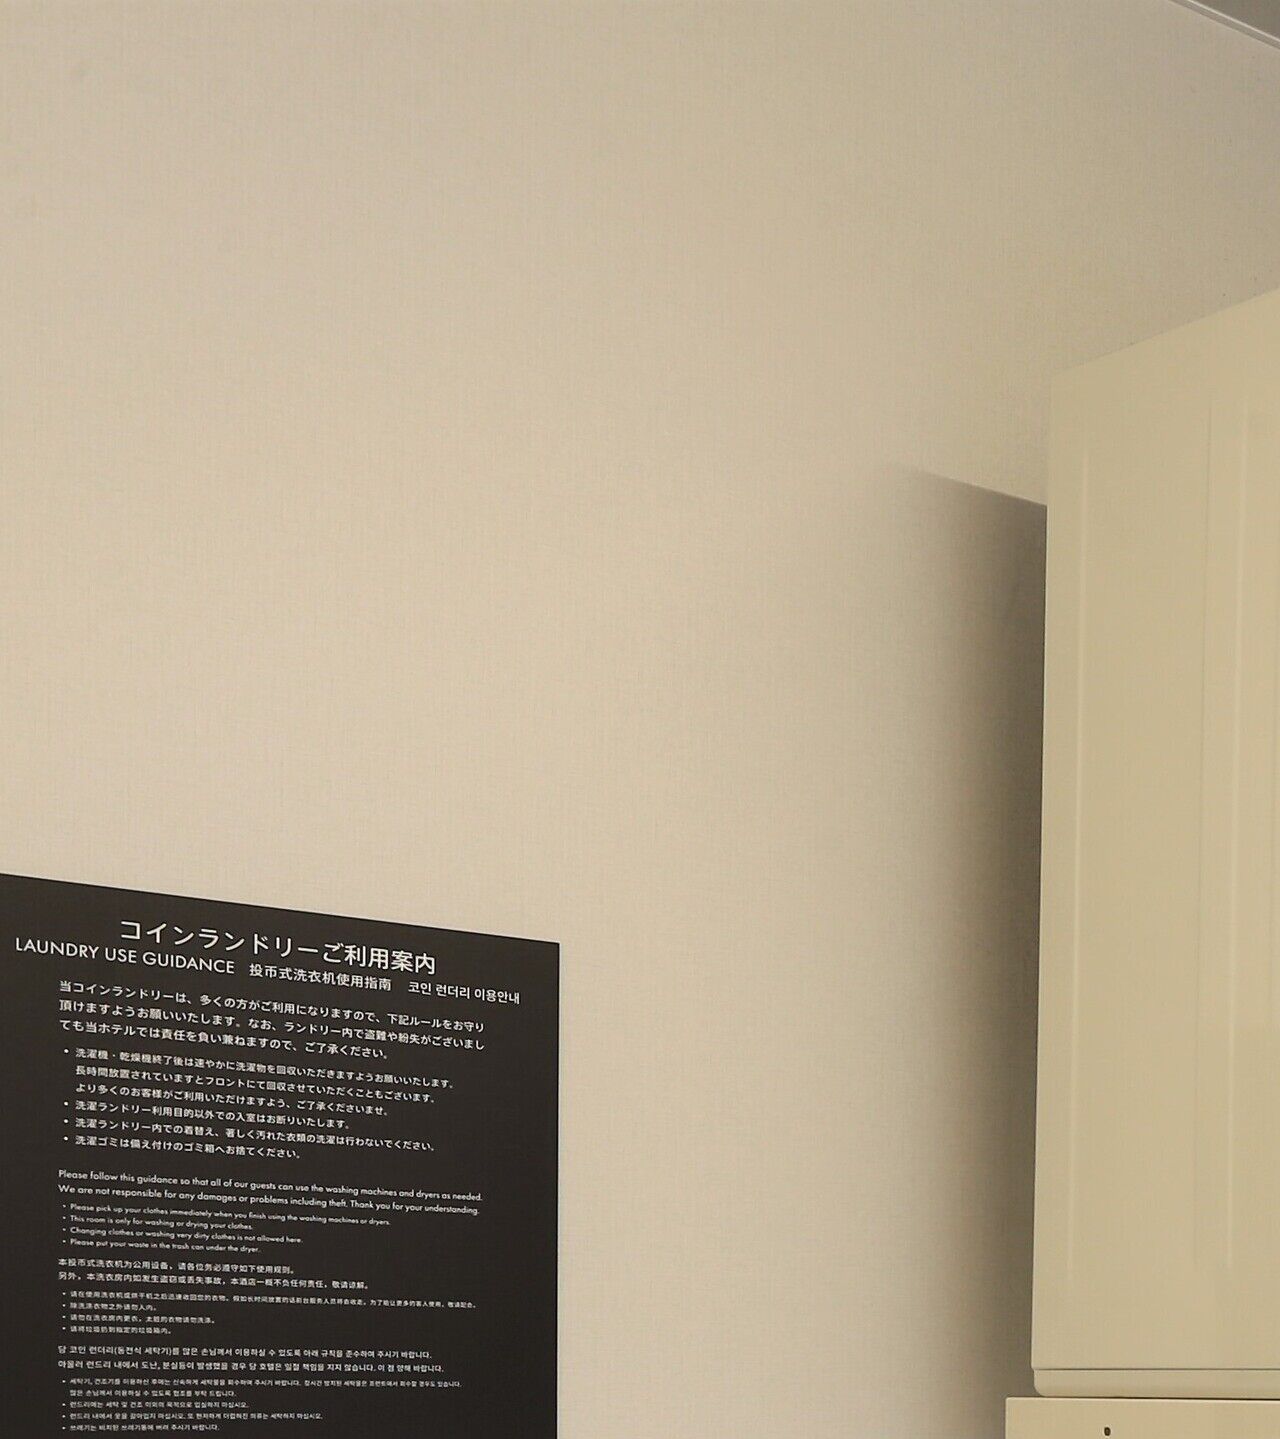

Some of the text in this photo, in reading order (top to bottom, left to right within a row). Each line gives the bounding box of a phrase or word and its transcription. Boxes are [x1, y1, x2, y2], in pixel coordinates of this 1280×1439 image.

[15, 937, 235, 975] LAUNDRY USE GUIDANCE
[120, 919, 436, 975] コインランドリーご利用案内
[249, 962, 392, 991] 投币式洗衣机使用指南
[408, 981, 520, 1005] 코인 런더리 이용안내
[57, 1169, 88, 1179] Please
[89, 1170, 118, 1180] follow
[119, 1172, 135, 1182] this
[136, 1174, 178, 1184] guidance
[191, 1176, 208, 1185] that
[209, 1178, 221, 1186] all
[249, 1182, 276, 1190] guests
[310, 1183, 324, 1192] the
[324, 1185, 359, 1196] washing
[360, 1187, 397, 1196] machines
[398, 1188, 414, 1197] and
[415, 1189, 440, 1199] dryers
[451, 1192, 483, 1200] needed.
[111, 1188, 162, 1197] responsible
[163, 1189, 176, 1198] for
[178, 1192, 195, 1201] any
[196, 1191, 237, 1203] damages
[249, 1194, 288, 1204] problems
[289, 1196, 327, 1208] including
[328, 1198, 349, 1207] theft.
[350, 1199, 374, 1208] Thank
[391, 1201, 403, 1210] for
[404, 1204, 422, 1212] your
[424, 1204, 480, 1215] understanding.
